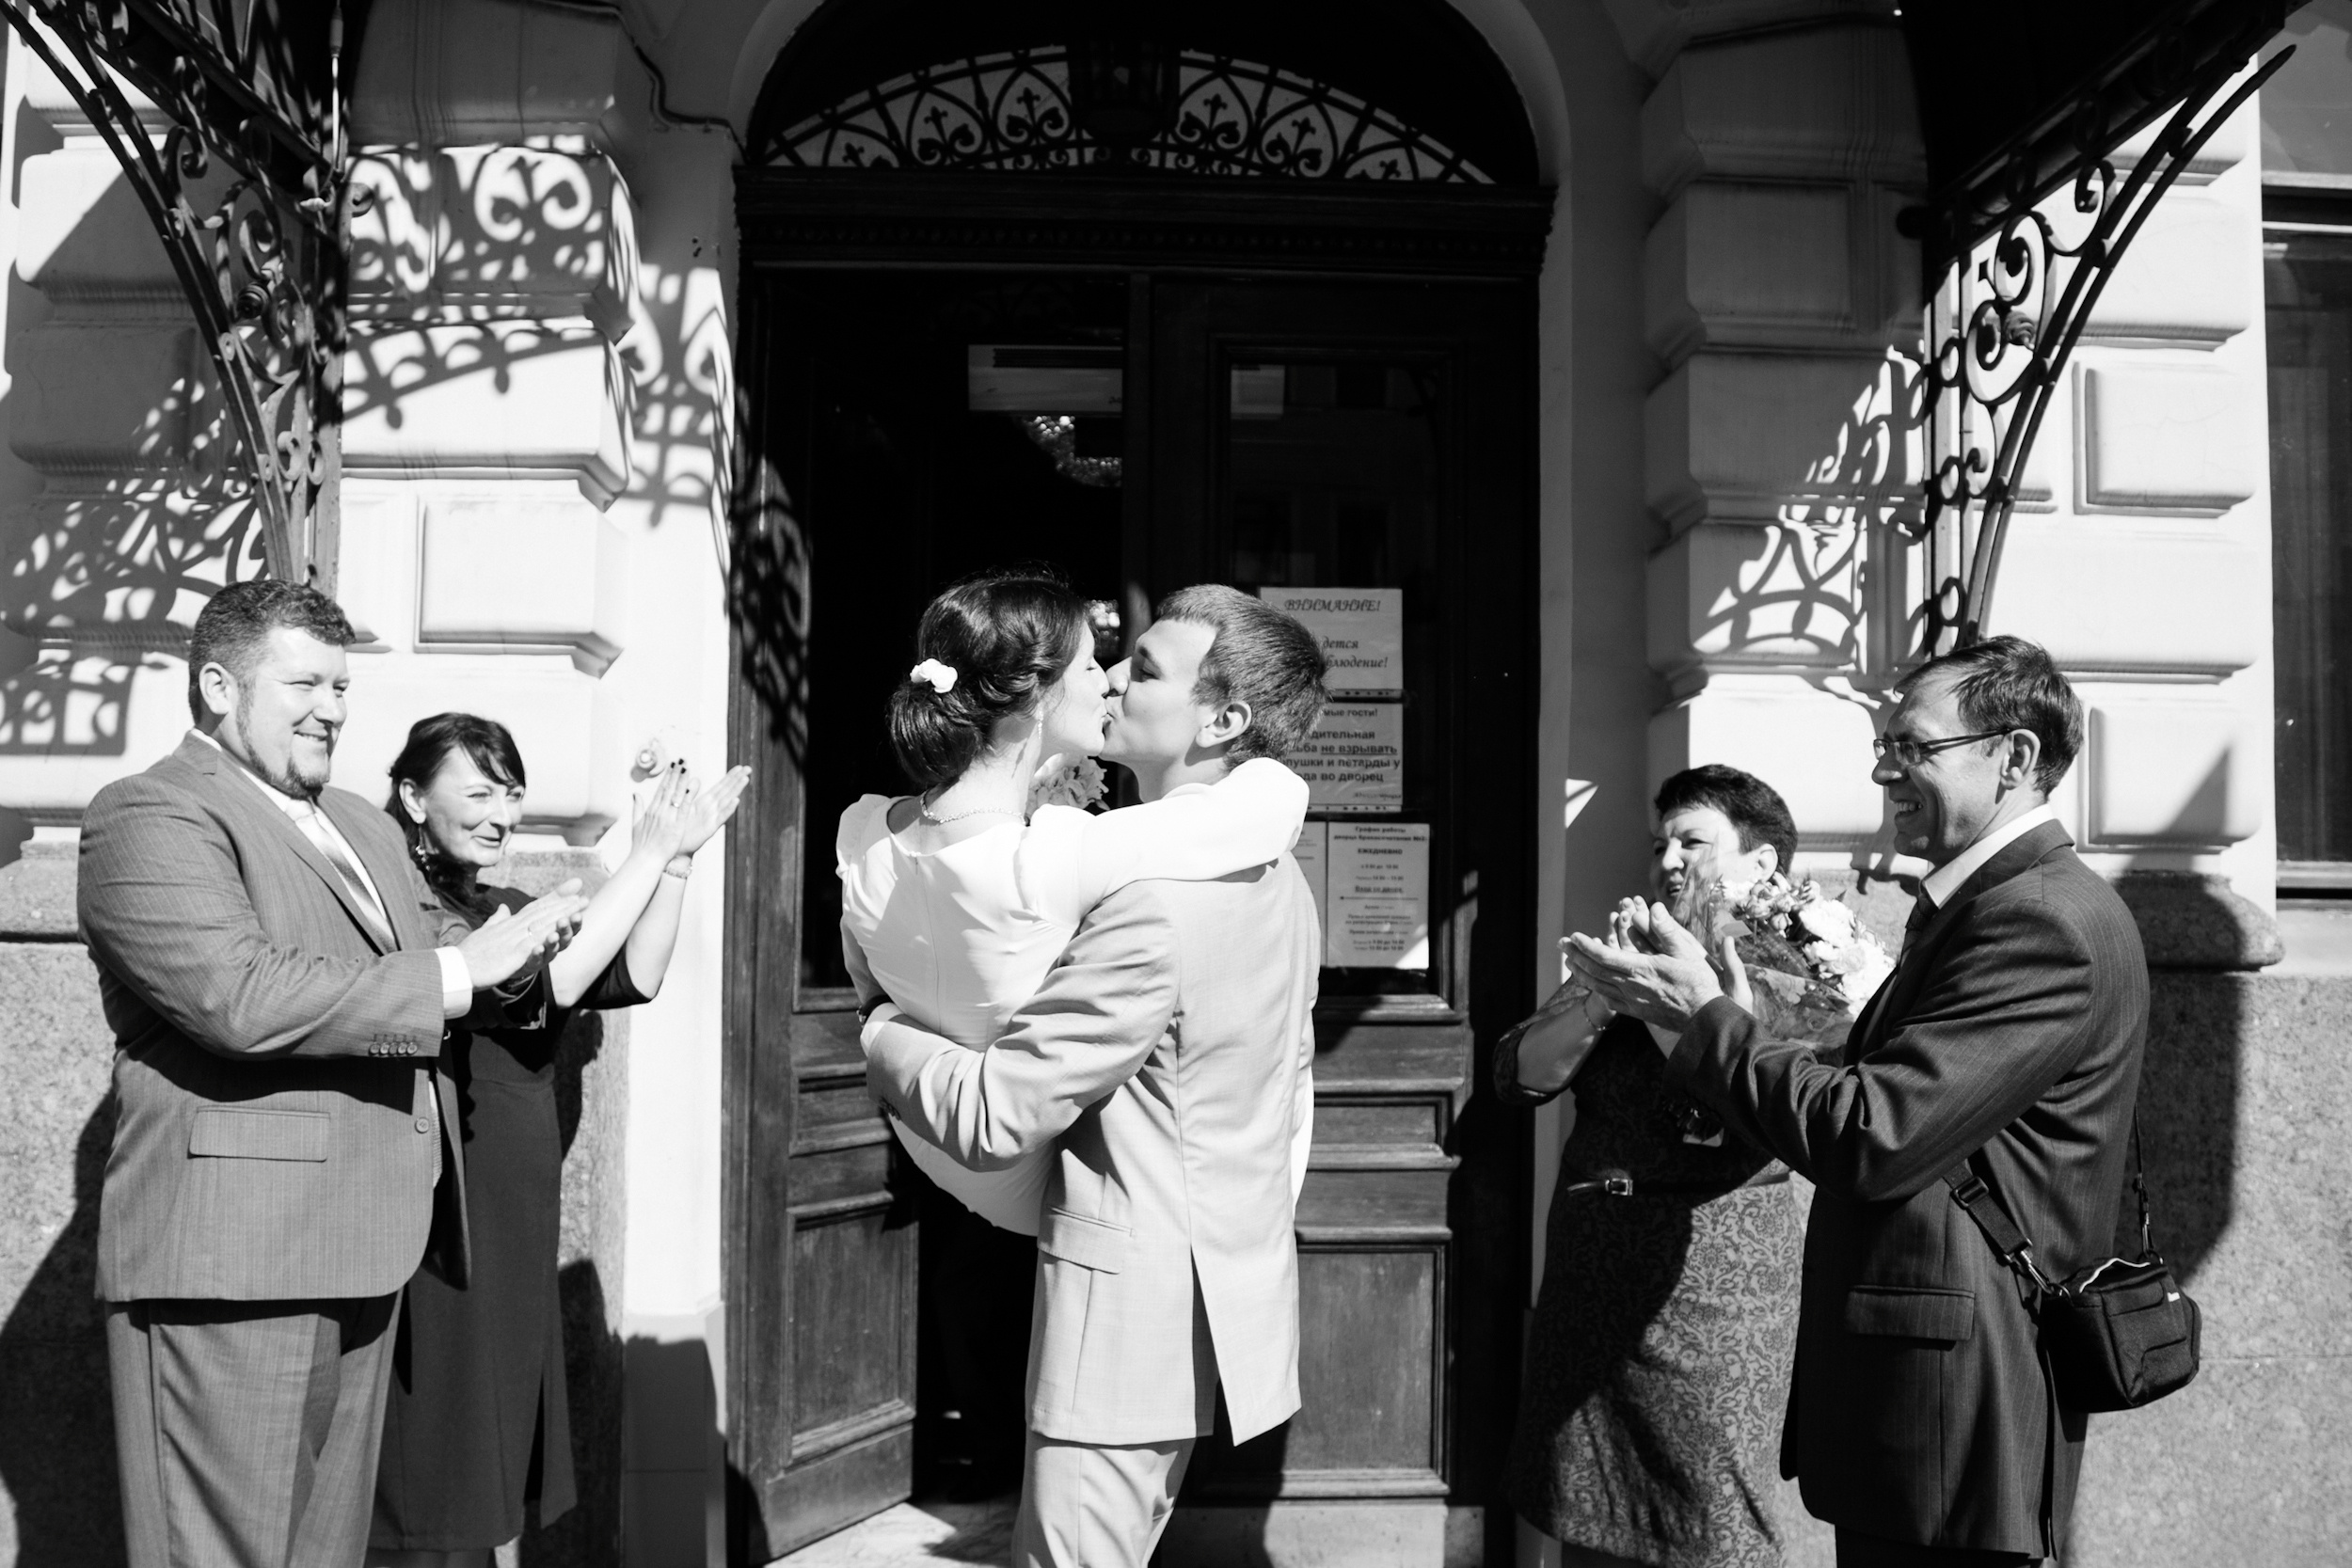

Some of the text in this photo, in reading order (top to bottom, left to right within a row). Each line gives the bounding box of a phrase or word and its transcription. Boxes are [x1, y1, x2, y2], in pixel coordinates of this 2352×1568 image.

[1284, 598, 1381, 612] ВНИМАНИЕ!
[1323, 635, 1359, 649] дется
[1326, 655, 1388, 668] блюдение!
[1347, 708, 1377, 717] гости!
[1311, 731, 1375, 739] дительная
[1321, 744, 1335, 752] не
[1339, 744, 1397, 753] взрывать
[1283, 758, 1324, 769] пушки
[1338, 758, 1391, 769] петарды
[1393, 759, 1401, 769] у
[1321, 773, 1336, 782] во
[1338, 773, 1384, 783] дворец
